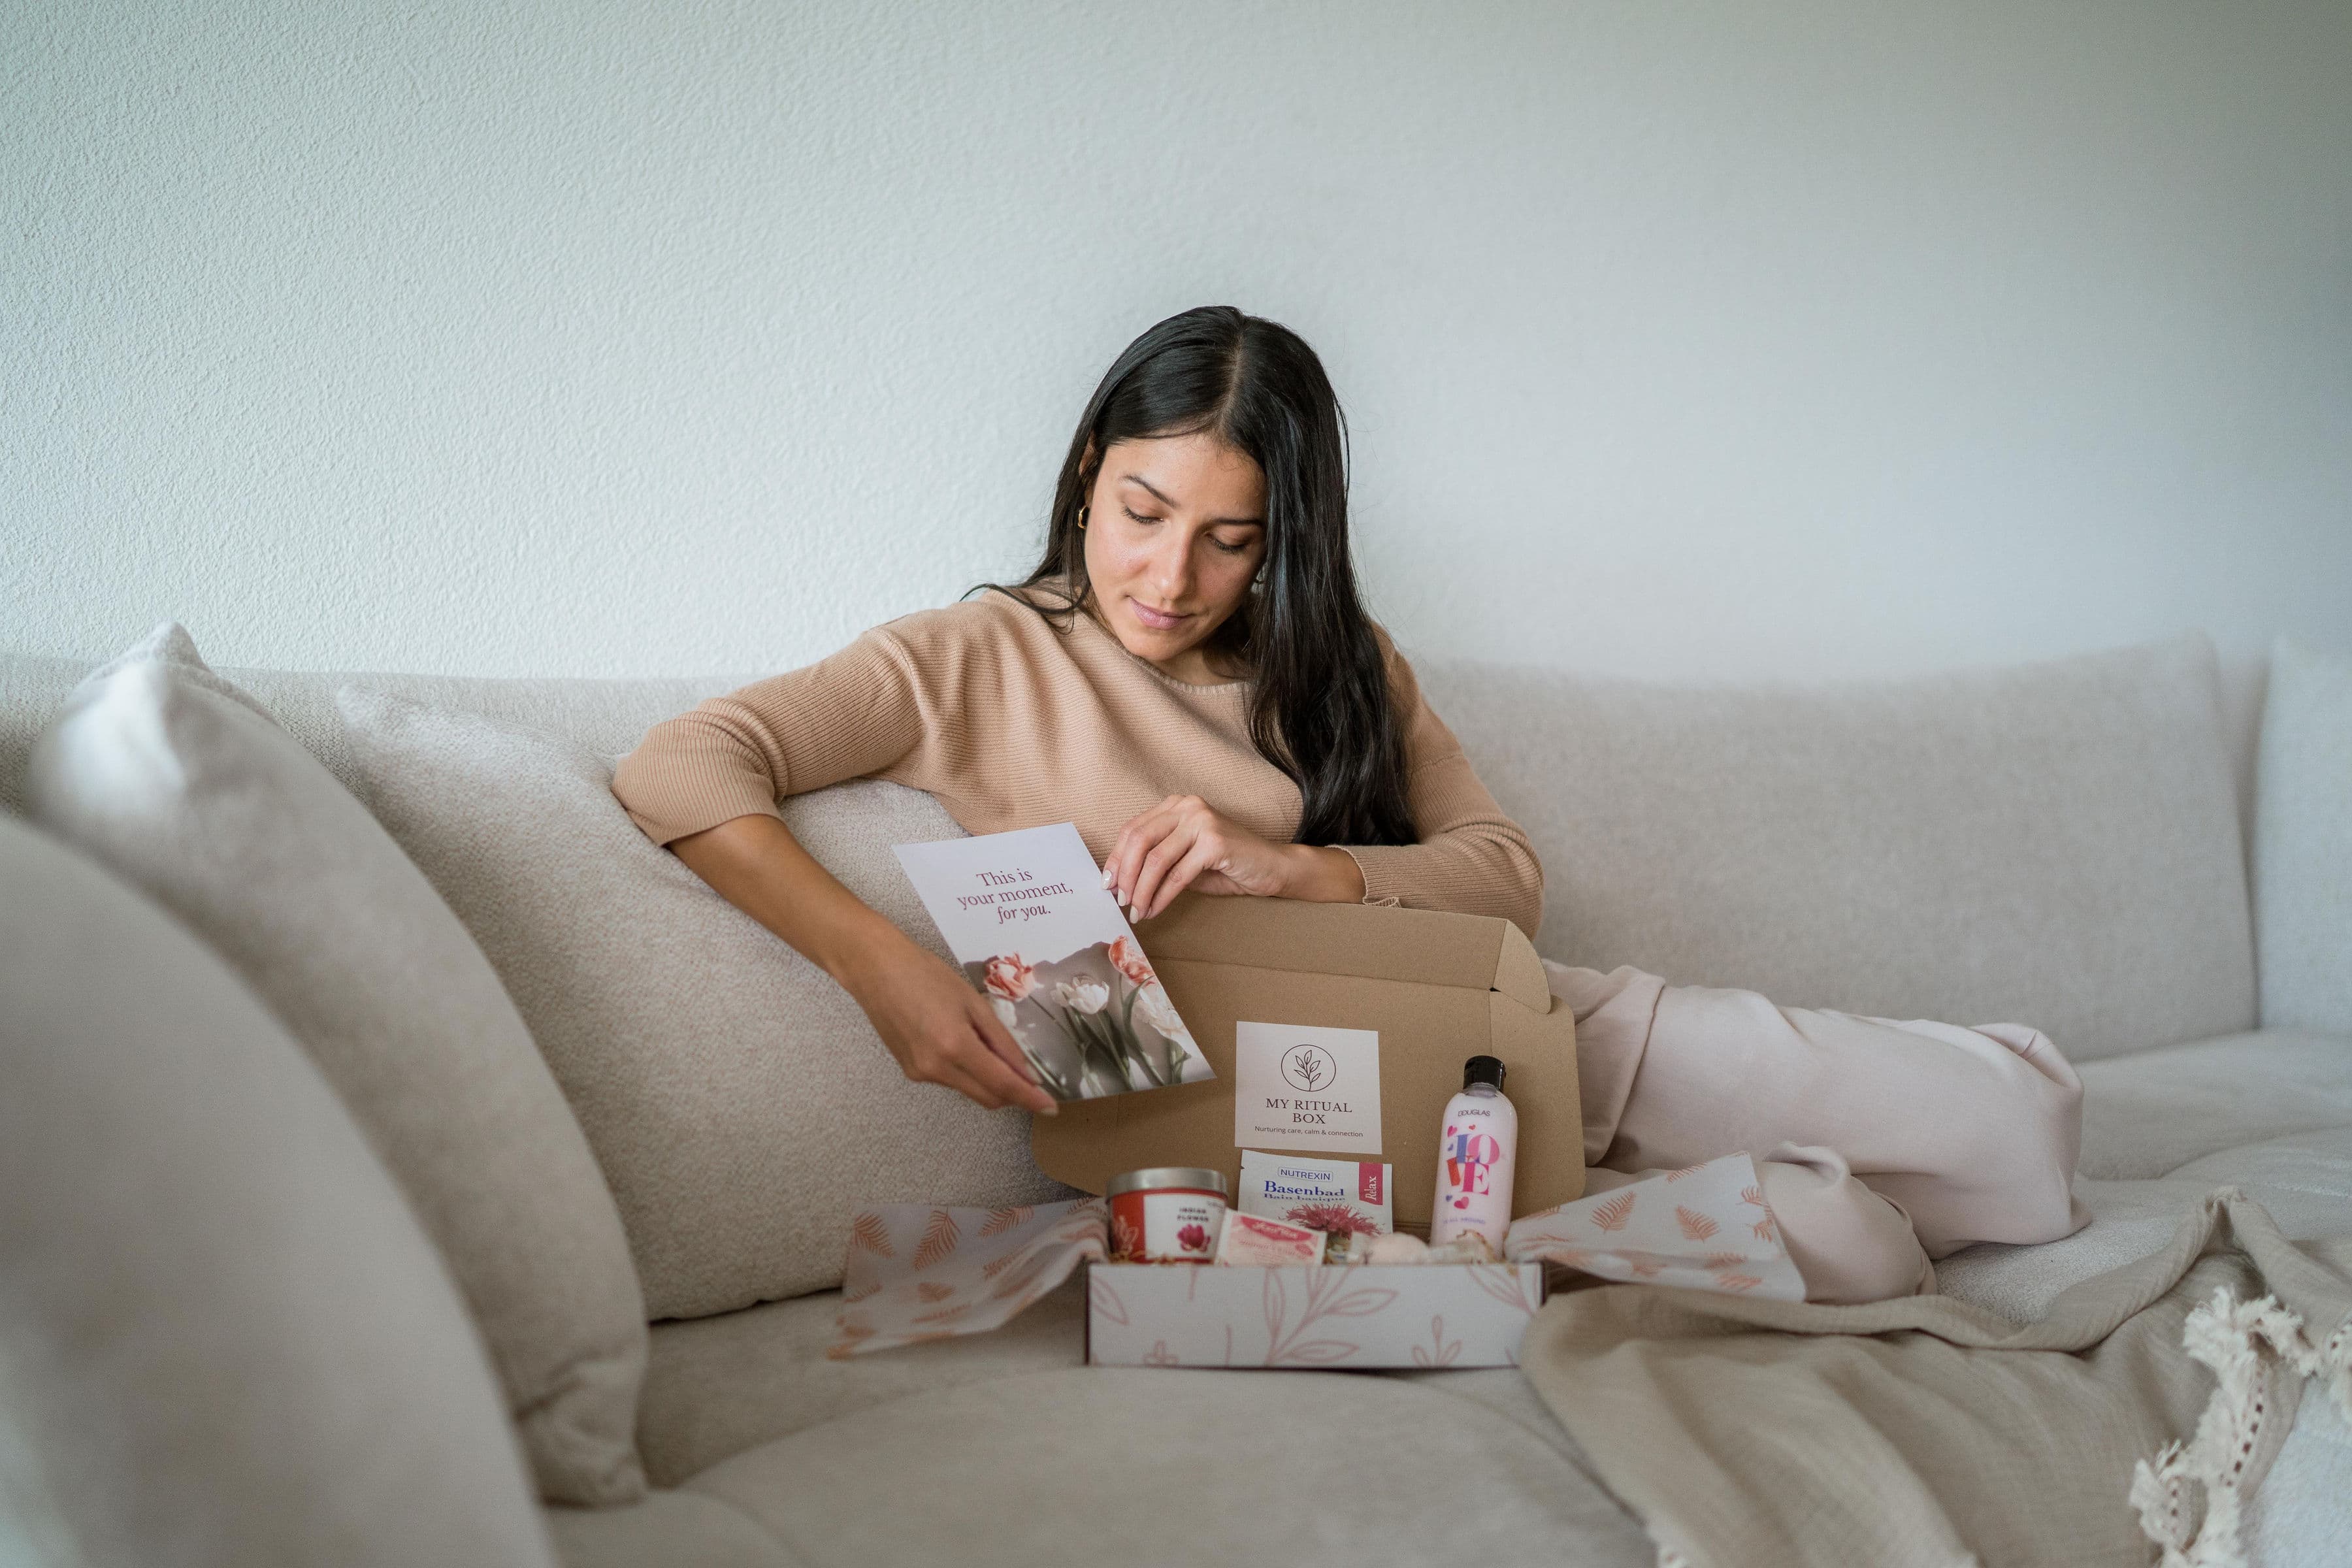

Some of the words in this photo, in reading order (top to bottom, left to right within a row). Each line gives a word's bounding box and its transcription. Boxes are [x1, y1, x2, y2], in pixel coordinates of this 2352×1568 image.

[976, 871, 1016, 886] This
[1017, 868, 1033, 881] is
[956, 893, 995, 910] your
[998, 882, 1073, 902] moment,
[997, 906, 1017, 924] for
[1021, 904, 1051, 921] you.
[1266, 1098, 1290, 1109] MY
[1294, 1100, 1352, 1113] RITUAL
[1292, 1113, 1326, 1124] BOX
[1254, 1126, 1286, 1135] Nurturing
[1280, 1168, 1331, 1181] NUTREXIN
[1264, 1180, 1345, 1197] Basenbad
[1364, 1175, 1377, 1201] Relax
